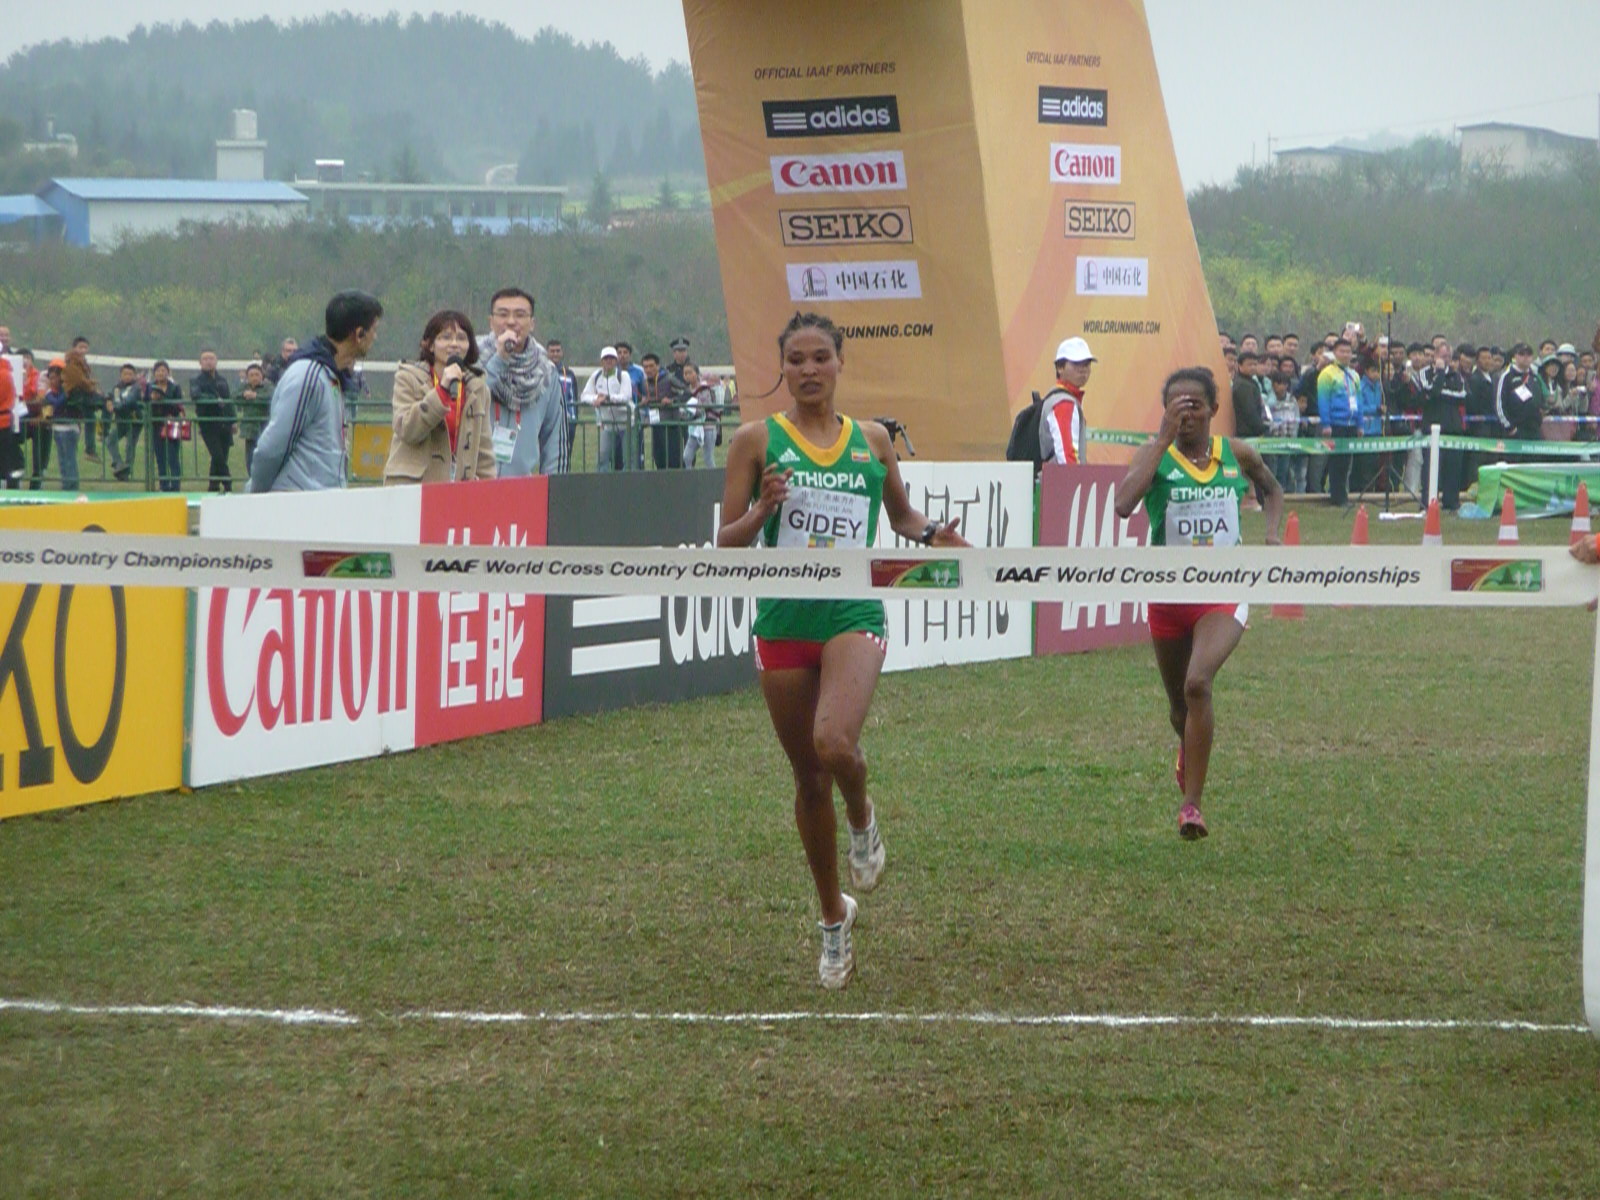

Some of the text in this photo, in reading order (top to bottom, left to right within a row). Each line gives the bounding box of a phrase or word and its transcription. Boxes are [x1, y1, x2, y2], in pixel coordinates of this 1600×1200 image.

[754, 62, 897, 80] OFFICIAL IAAF PARTNERS
[1026, 51, 1102, 67] OFFICIAL IAAF PARTNERS
[809, 104, 891, 129] adidas
[1061, 94, 1104, 119] adidas
[780, 160, 898, 187] Canon
[1054, 148, 1115, 178] Canon
[788, 212, 904, 241] SEIKO
[1068, 206, 1132, 234] SEIKO
[1083, 319, 1161, 334] WORLDRUNNING.COM
[1170, 486, 1239, 501] ETHIOPIA
[788, 509, 863, 540] GIDEY
[1178, 518, 1229, 536] DIDA
[41, 549, 118, 570] Country
[123, 551, 274, 573] Championships
[424, 558, 842, 582] IAAF World Cross Country Championships
[995, 566, 1421, 588] IAAF World Cross Country Championships
[206, 587, 409, 737] Canon
